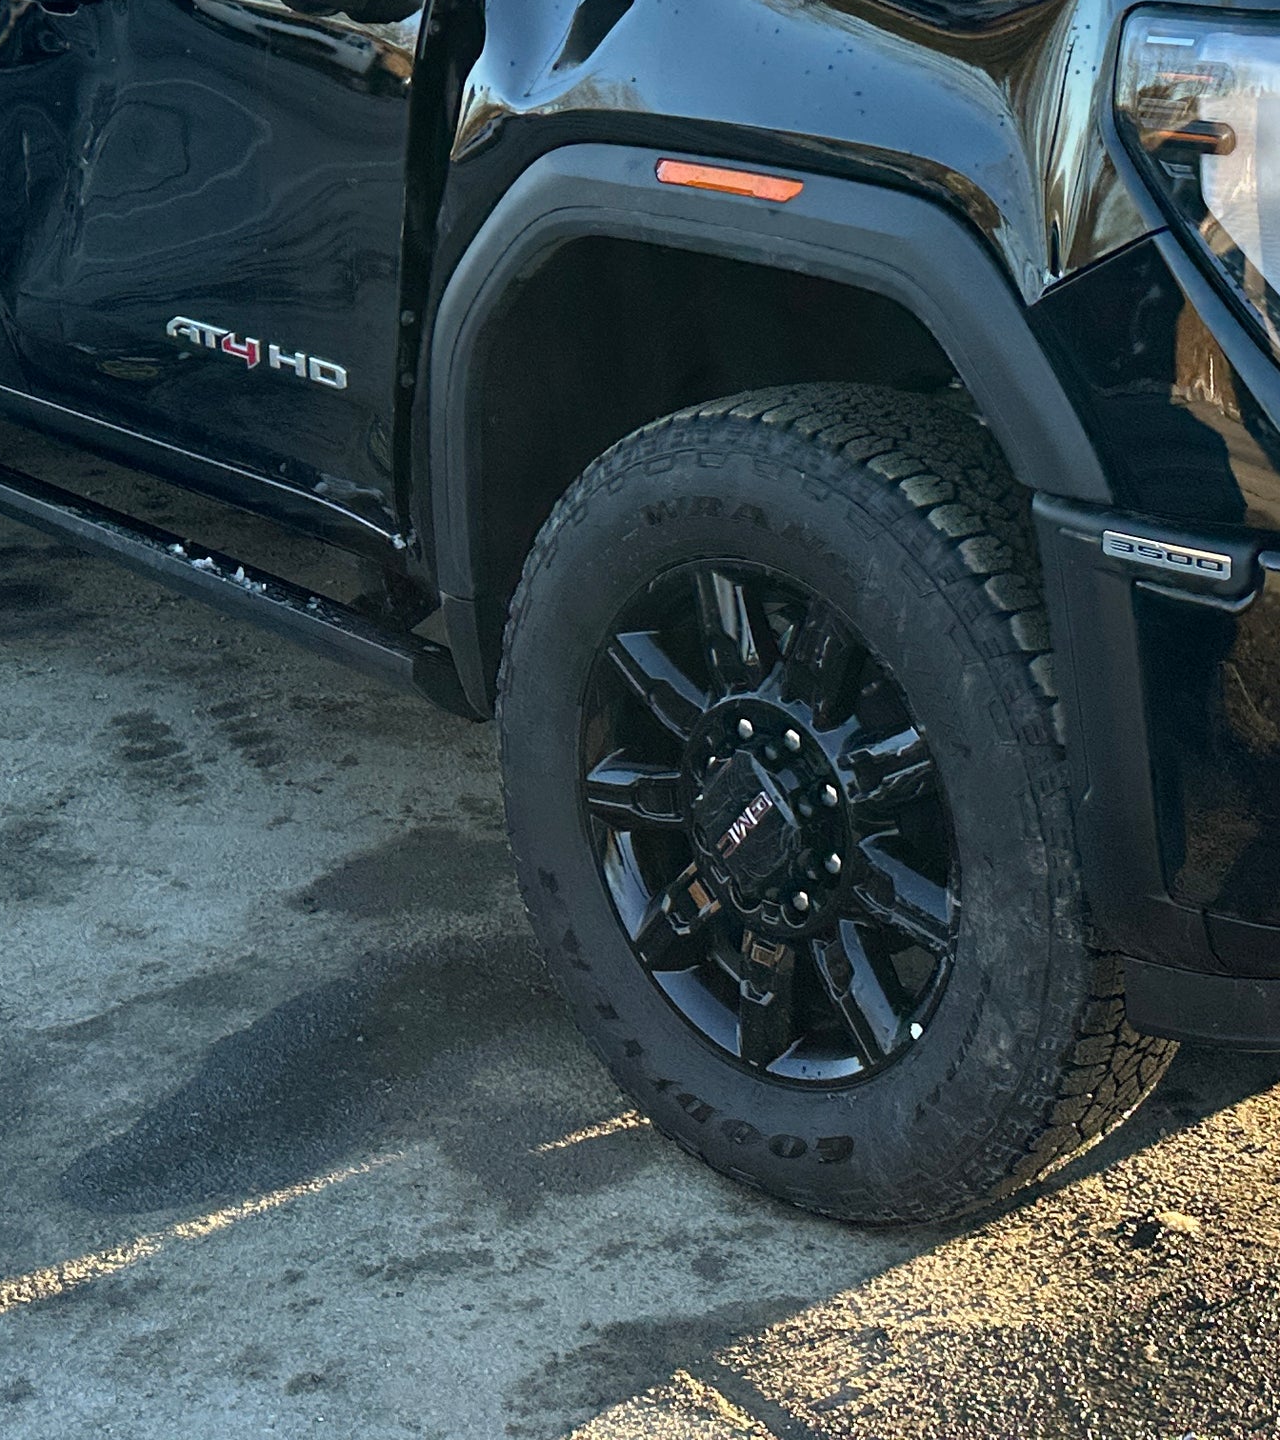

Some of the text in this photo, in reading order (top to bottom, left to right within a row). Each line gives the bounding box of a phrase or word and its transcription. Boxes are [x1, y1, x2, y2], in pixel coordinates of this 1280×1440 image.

[166, 316, 347, 389] AT4 HD
[1109, 539, 1224, 572] 3500
[716, 791, 773, 859] GMC
